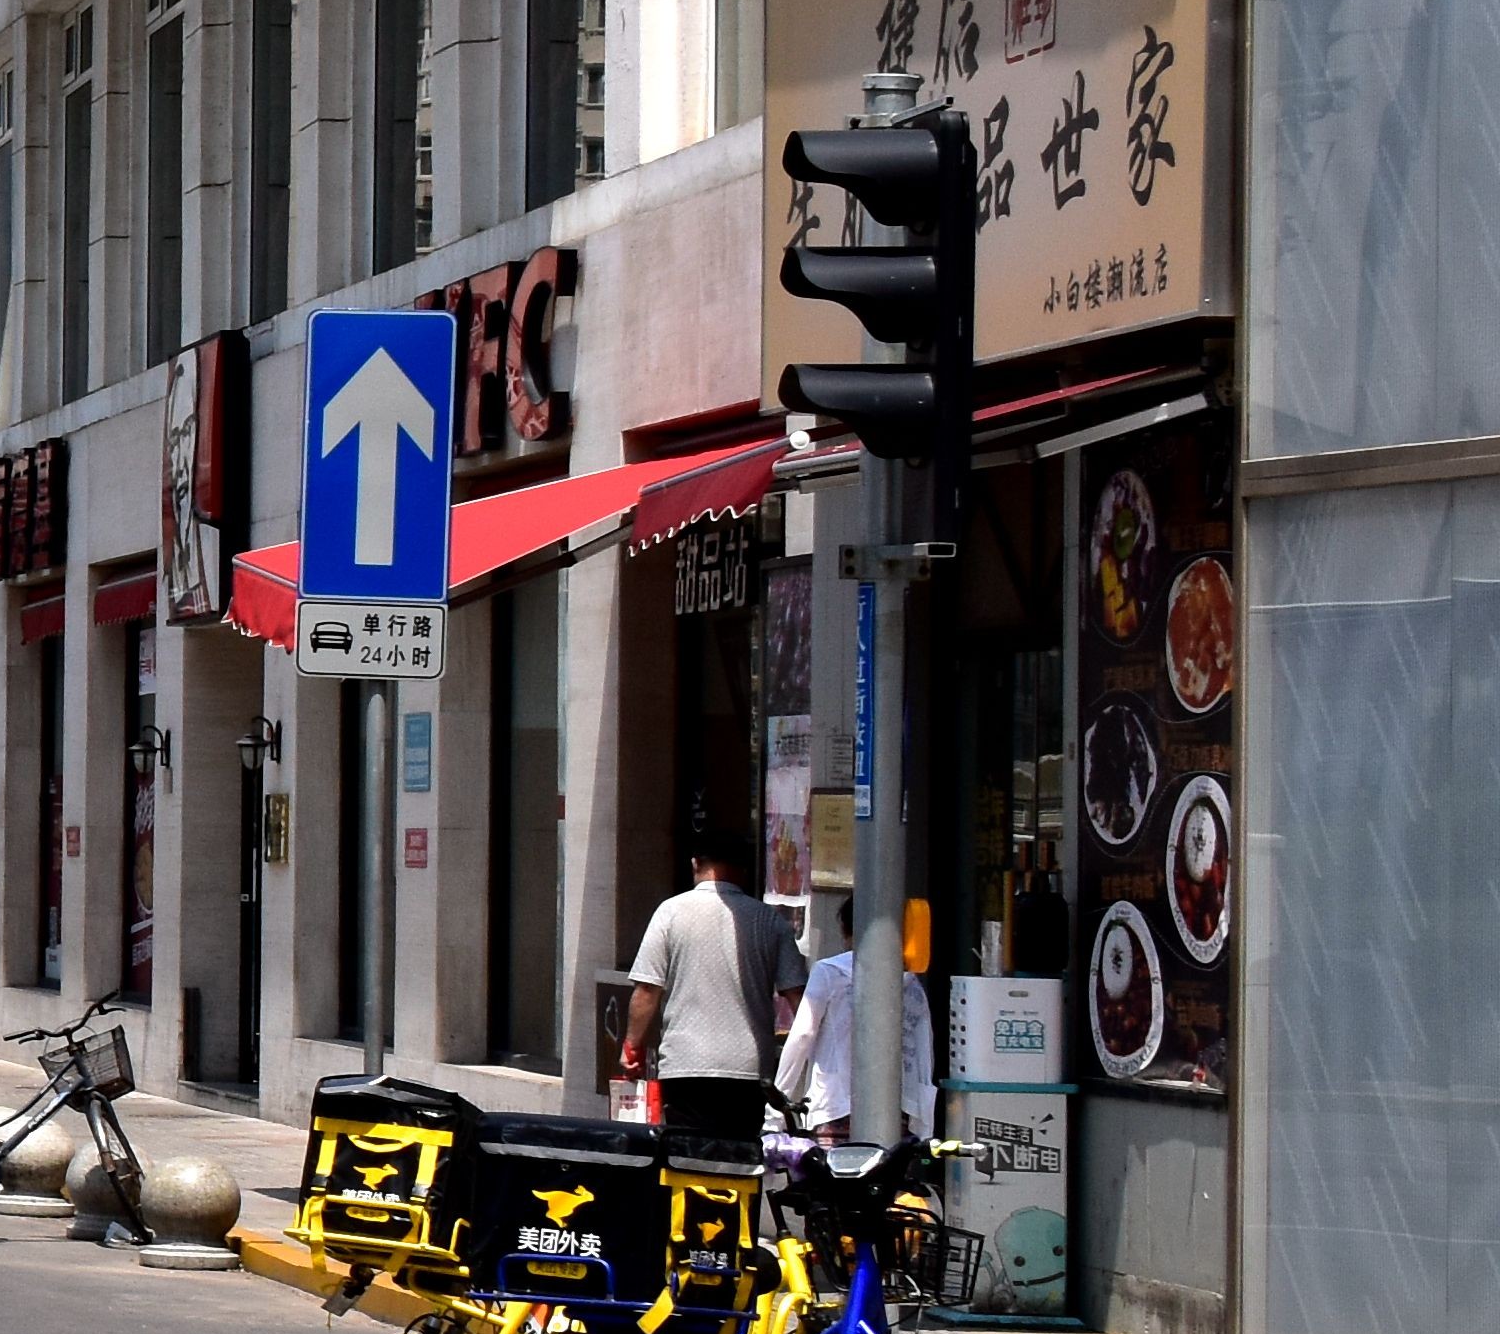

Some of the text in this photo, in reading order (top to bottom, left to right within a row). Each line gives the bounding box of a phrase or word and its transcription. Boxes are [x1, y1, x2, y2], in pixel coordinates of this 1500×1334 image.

[415, 246, 560, 454] FC
[675, 525, 749, 615] 甜品站
[362, 613, 432, 638] 单行路
[360, 644, 431, 668] 24小时
[975, 1119, 1031, 1143] 玩转生活
[976, 1137, 1060, 1172] 不断电
[517, 1226, 602, 1258] 美团外卖
